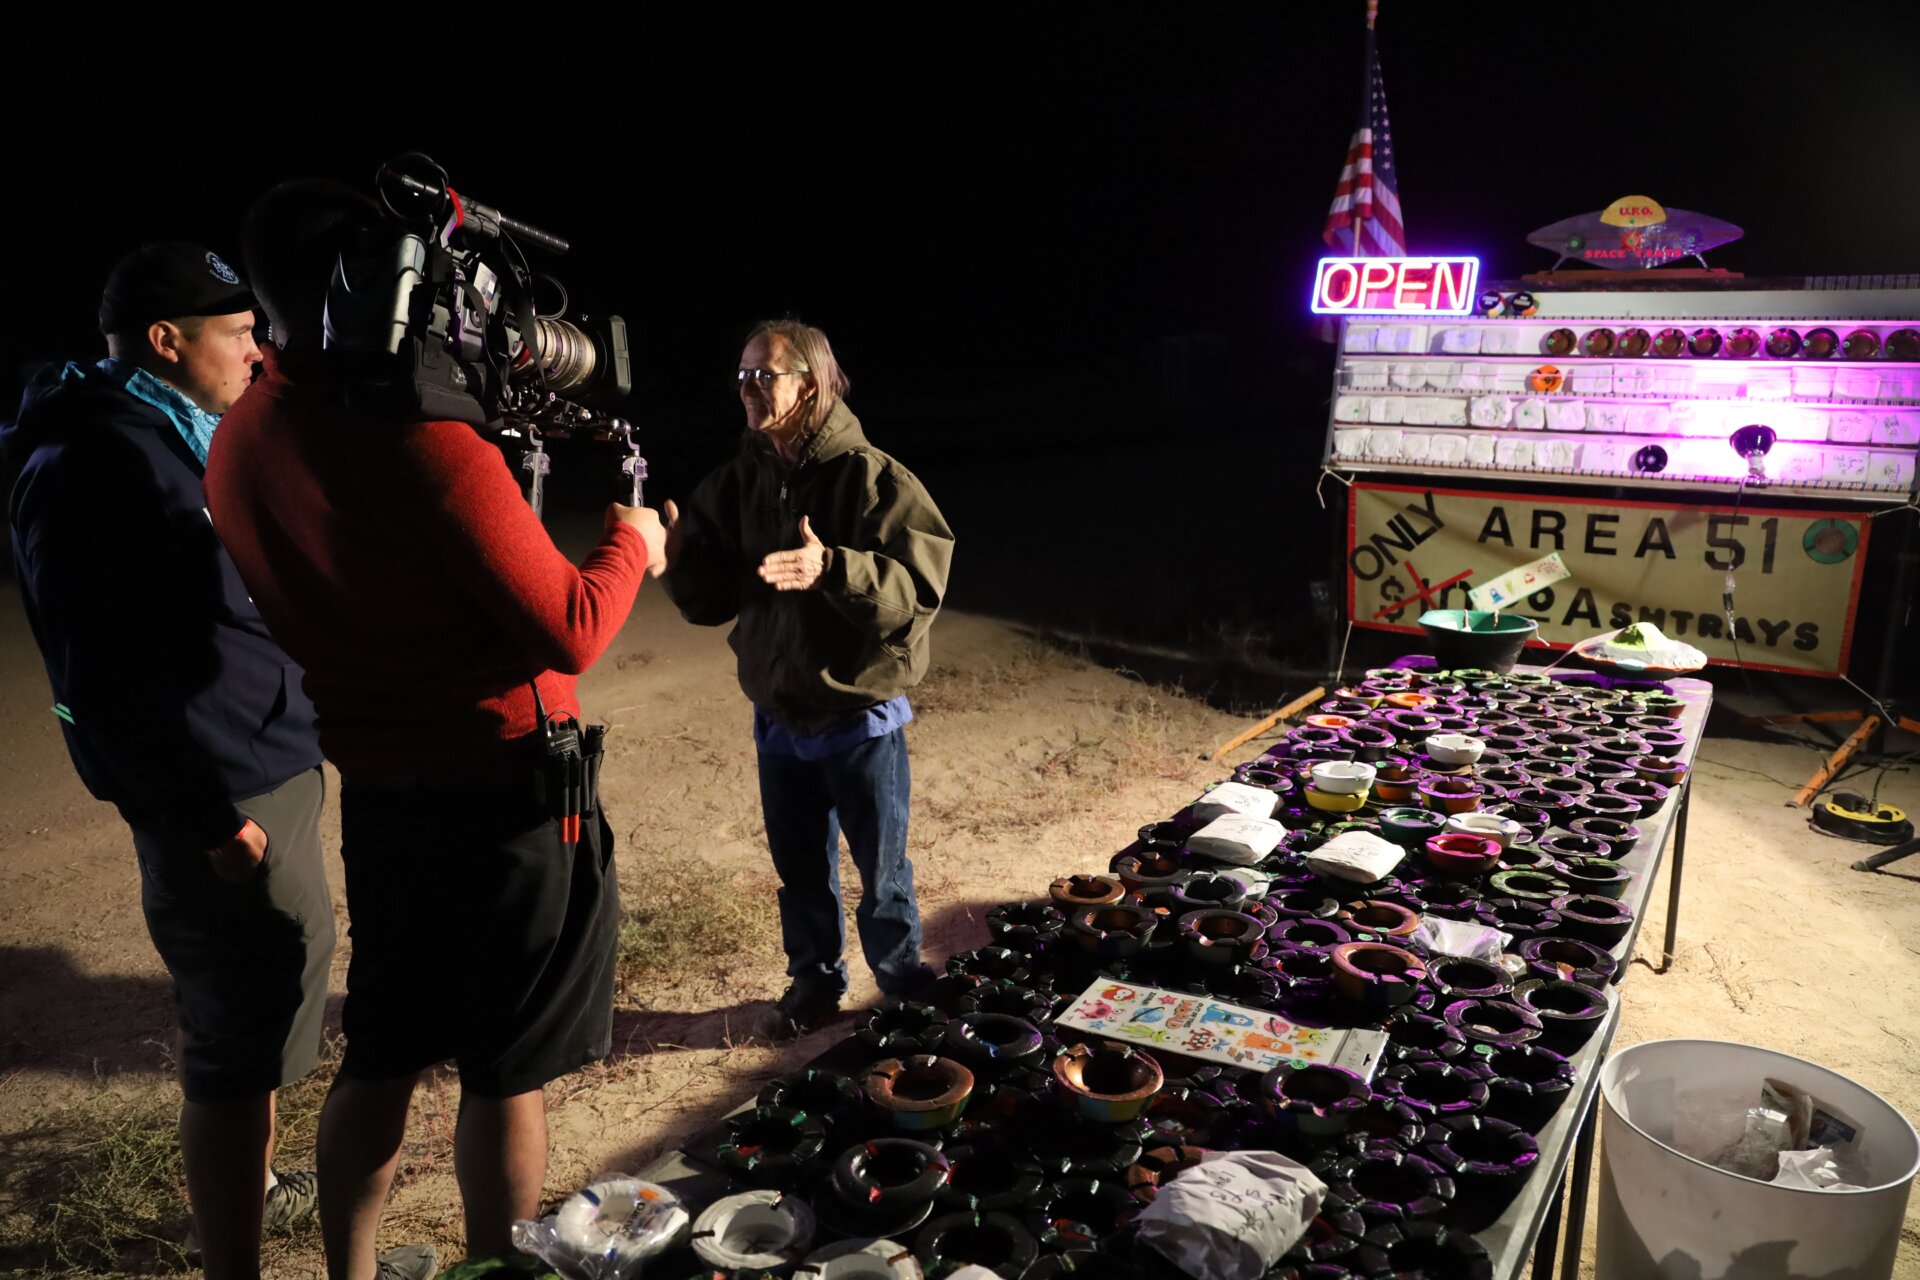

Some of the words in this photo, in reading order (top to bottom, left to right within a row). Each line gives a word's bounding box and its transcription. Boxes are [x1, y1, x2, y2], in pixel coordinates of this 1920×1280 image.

[1584, 249, 1626, 258] SPACE
[1321, 262, 1471, 310] OPEN
[1350, 490, 1445, 581] ONLY
[1477, 506, 1677, 560] AREA
[1704, 514, 1779, 574] 51
